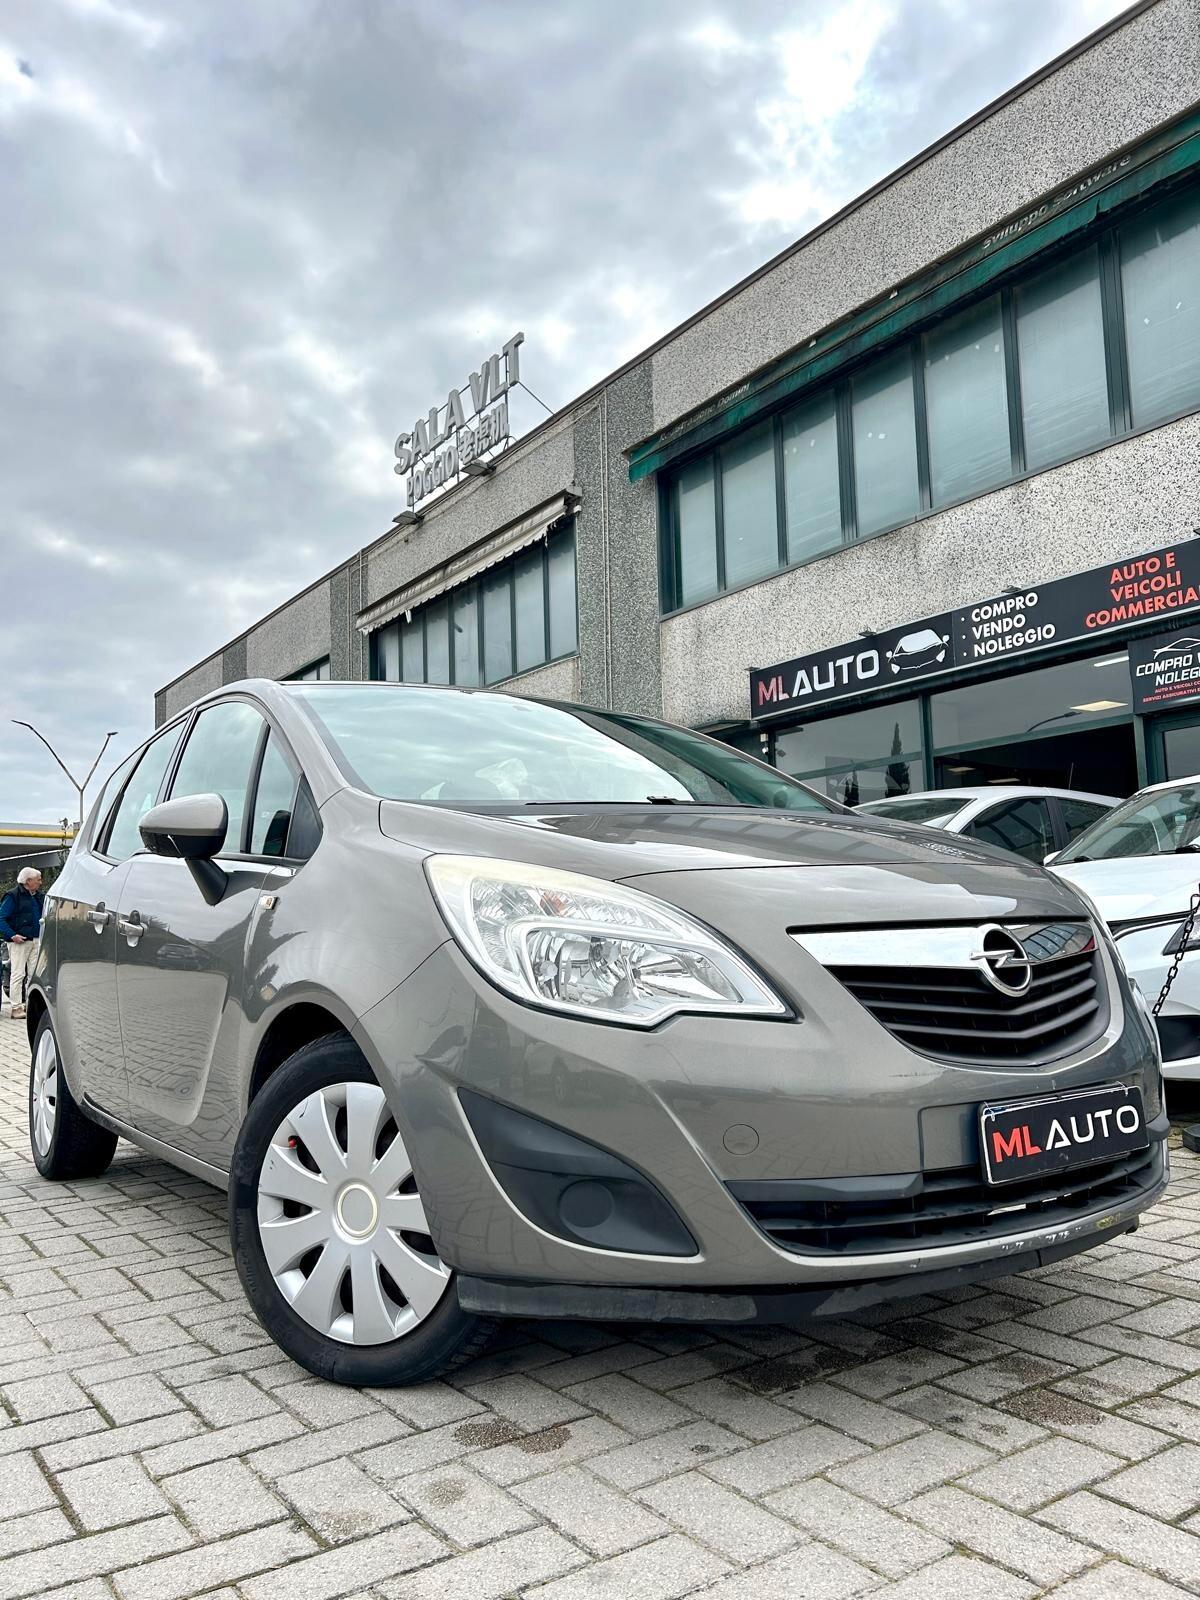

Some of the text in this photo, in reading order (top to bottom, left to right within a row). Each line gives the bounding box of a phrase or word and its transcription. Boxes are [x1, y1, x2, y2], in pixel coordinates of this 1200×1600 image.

[394, 332, 524, 475] SALA VLT
[460, 403, 509, 466] 老虎机
[407, 445, 459, 507] POGGIO
[1110, 552, 1175, 584] AUTO E
[1110, 570, 1181, 602] VEICOLI
[971, 592, 1038, 622] COMPRO
[1086, 585, 1200, 628] COMMERCIA
[972, 614, 1026, 640] VENDO
[973, 624, 1056, 657] NOLEGGIO
[758, 649, 880, 705] ML AUTO
[1136, 654, 1193, 677] COMPRO
[1155, 666, 1200, 687] NOLEG
[992, 1105, 1139, 1163] ML AUTO
